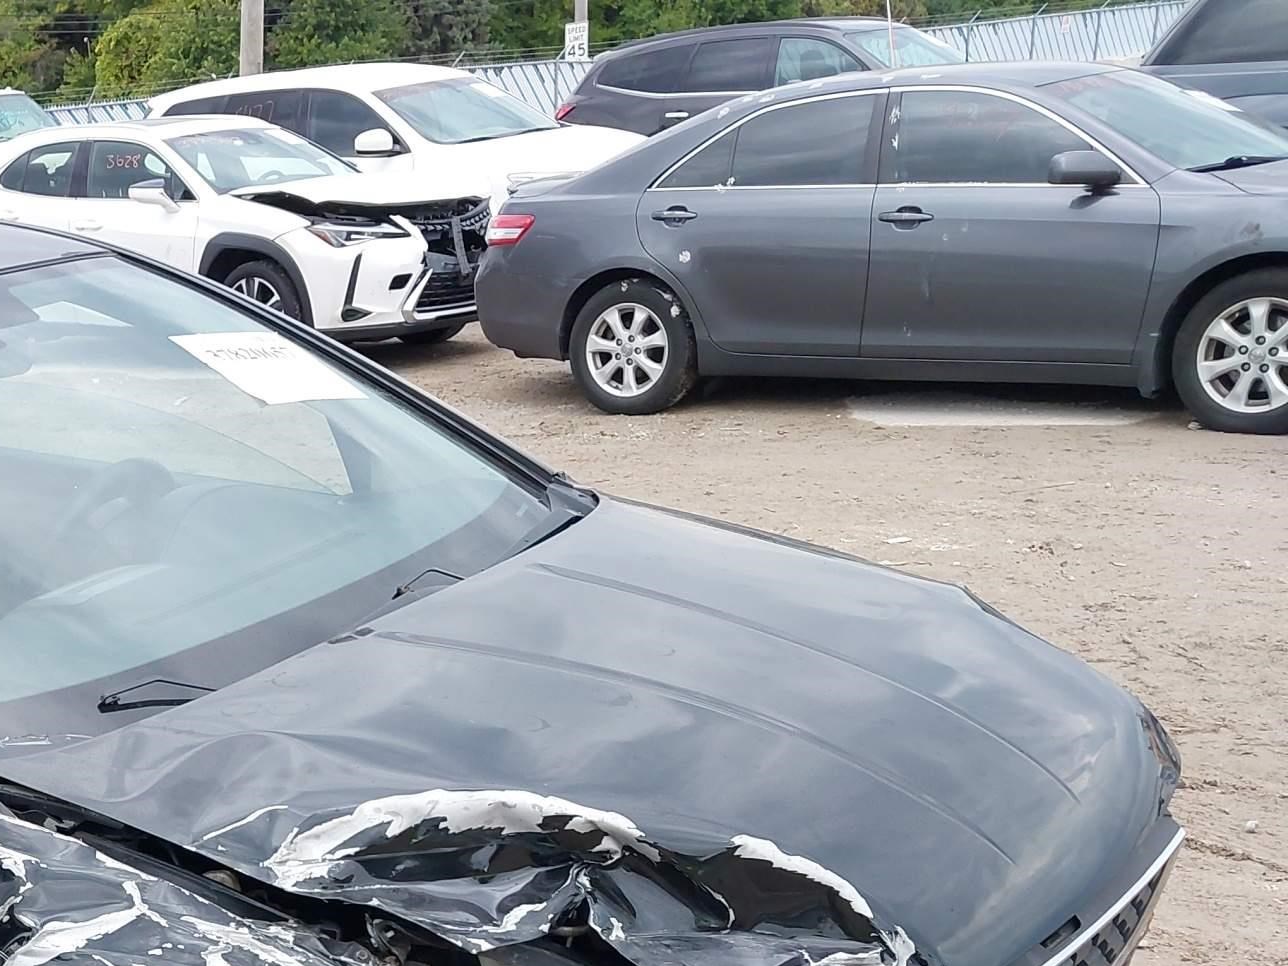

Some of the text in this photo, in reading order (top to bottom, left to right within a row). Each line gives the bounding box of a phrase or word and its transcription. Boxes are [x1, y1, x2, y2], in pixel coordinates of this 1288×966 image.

[569, 34, 584, 42] LIMIT
[568, 43, 586, 58] 45
[105, 153, 141, 169] 3628
